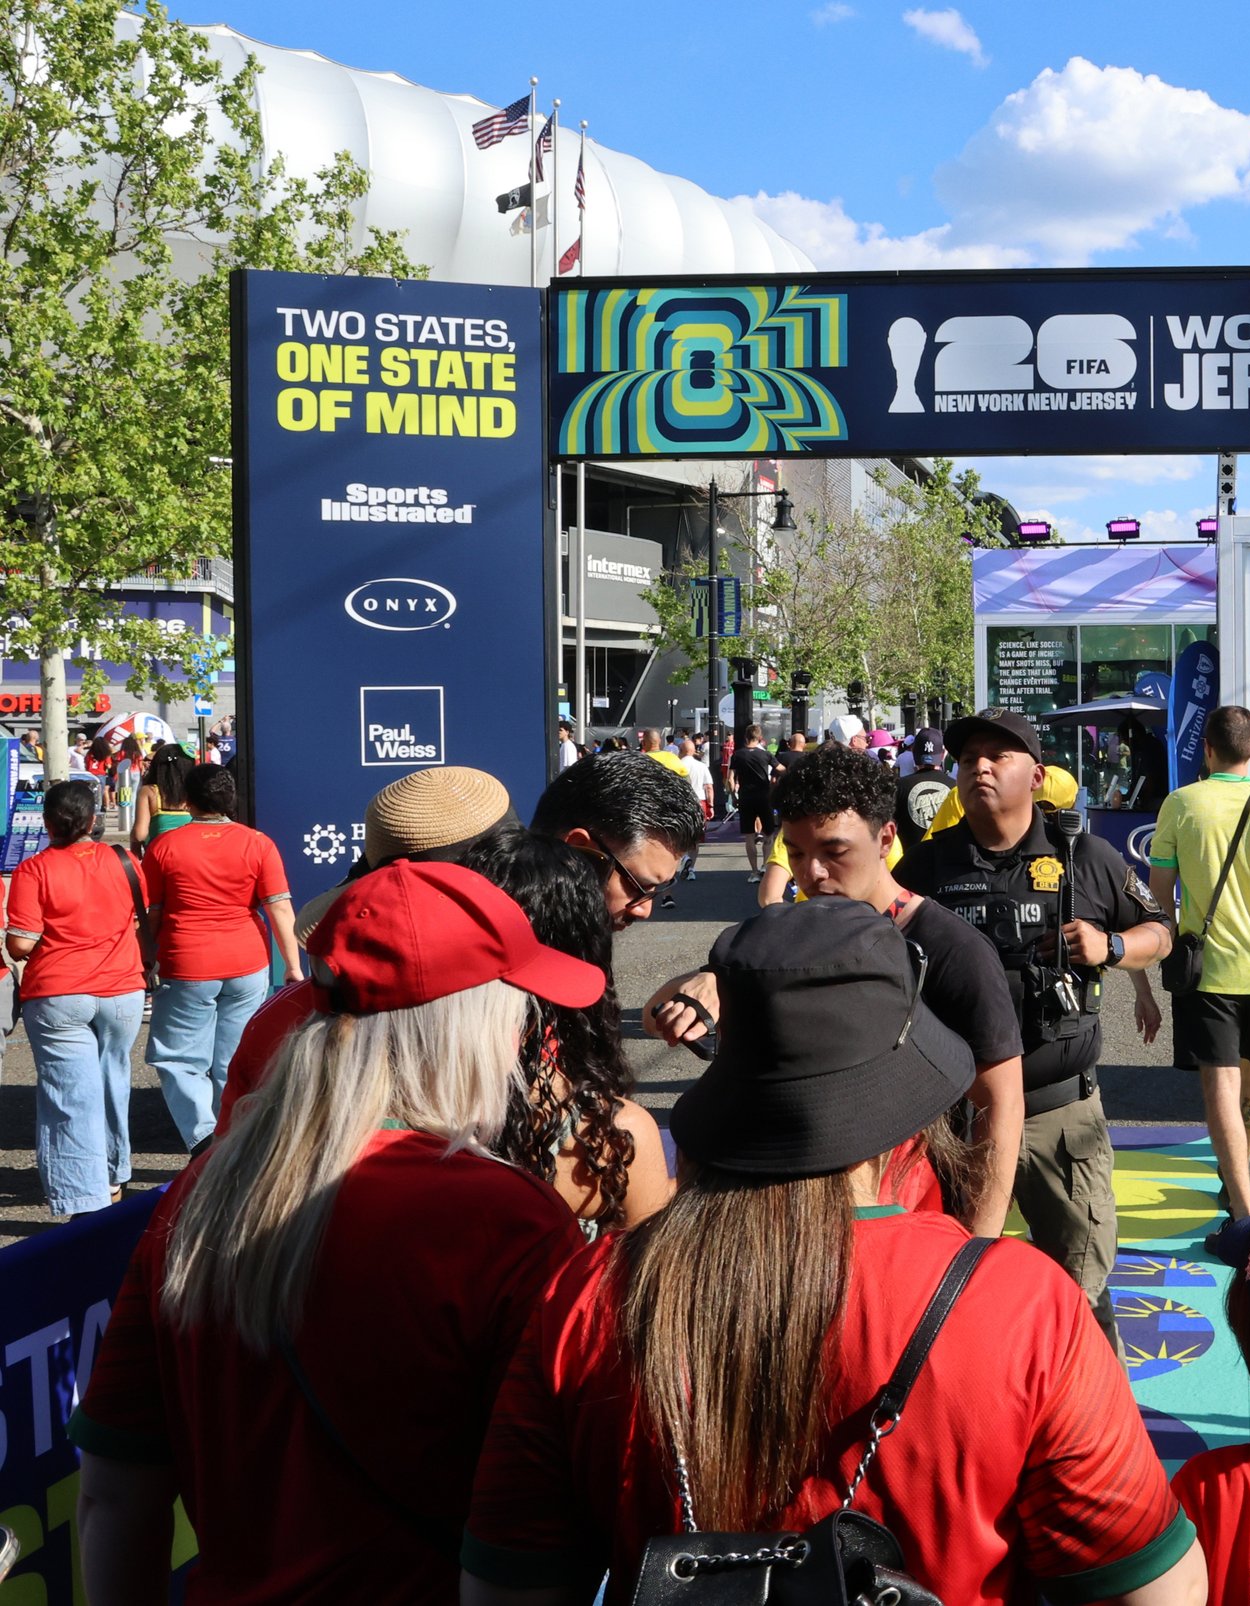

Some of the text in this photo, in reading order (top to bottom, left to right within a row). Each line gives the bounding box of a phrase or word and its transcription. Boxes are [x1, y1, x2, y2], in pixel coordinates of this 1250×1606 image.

[276, 307, 516, 352] TWO STATES,
[276, 341, 516, 391] ONE STATE
[1066, 359, 1111, 375] FIFA
[934, 391, 1137, 412] NEW YORK NEW JERSEY
[277, 387, 517, 438] OF MIND
[345, 483, 448, 507] Sports
[321, 498, 472, 524] Illustrated
[587, 554, 651, 580] intermex
[363, 597, 438, 613] ONYX
[723, 580, 736, 634] THANK YOU
[999, 650, 1006, 658] IS
[1007, 650, 1011, 658] A
[1011, 650, 1028, 658] GAME
[1029, 650, 1037, 658] OF
[1026, 641, 1039, 649] LIKE
[999, 659, 1064, 668] MANY SHOTS MISS, BUT
[999, 669, 1011, 677] THE
[1012, 669, 1027, 677] ONES
[999, 678, 1022, 686] CHANGE
[999, 687, 1053, 695] TRIAL AFTER TRIAL.
[369, 723, 416, 748] Paul,
[1180, 705, 1206, 762] Horizon
[217, 743, 231, 752] 26
[374, 740, 437, 759] Weiss
[944, 882, 988, 893] TARAZONA
[1020, 903, 1041, 923] K9
